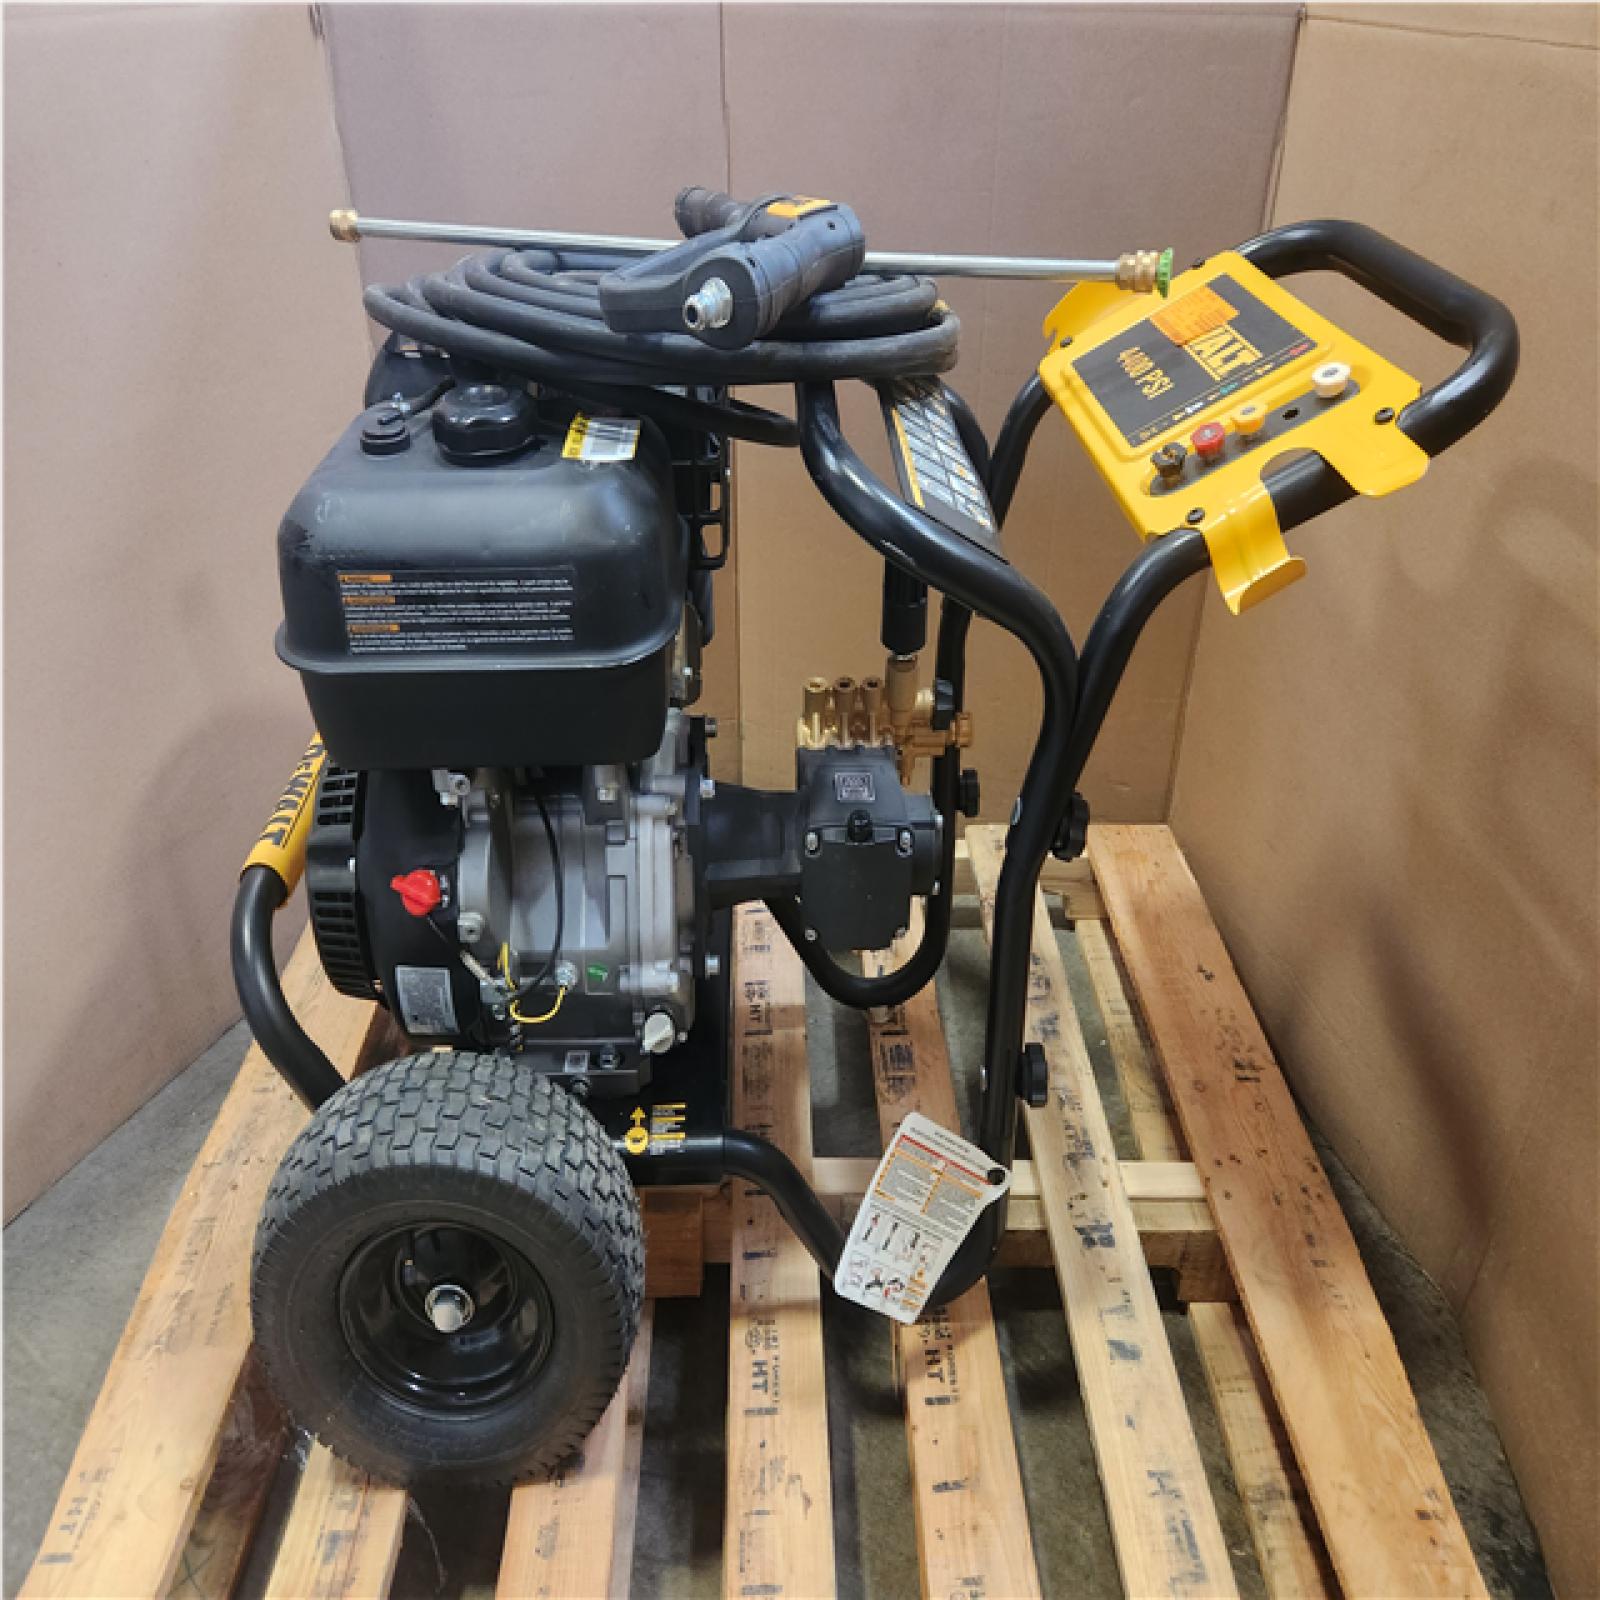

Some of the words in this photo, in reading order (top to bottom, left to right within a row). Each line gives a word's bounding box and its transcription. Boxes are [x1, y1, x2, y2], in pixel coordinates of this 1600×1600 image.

[1187, 327, 1259, 379] ALT
[1135, 369, 1175, 400] PSI
[752, 1359, 769, 1393] HT
[925, 1349, 946, 1384] HT
